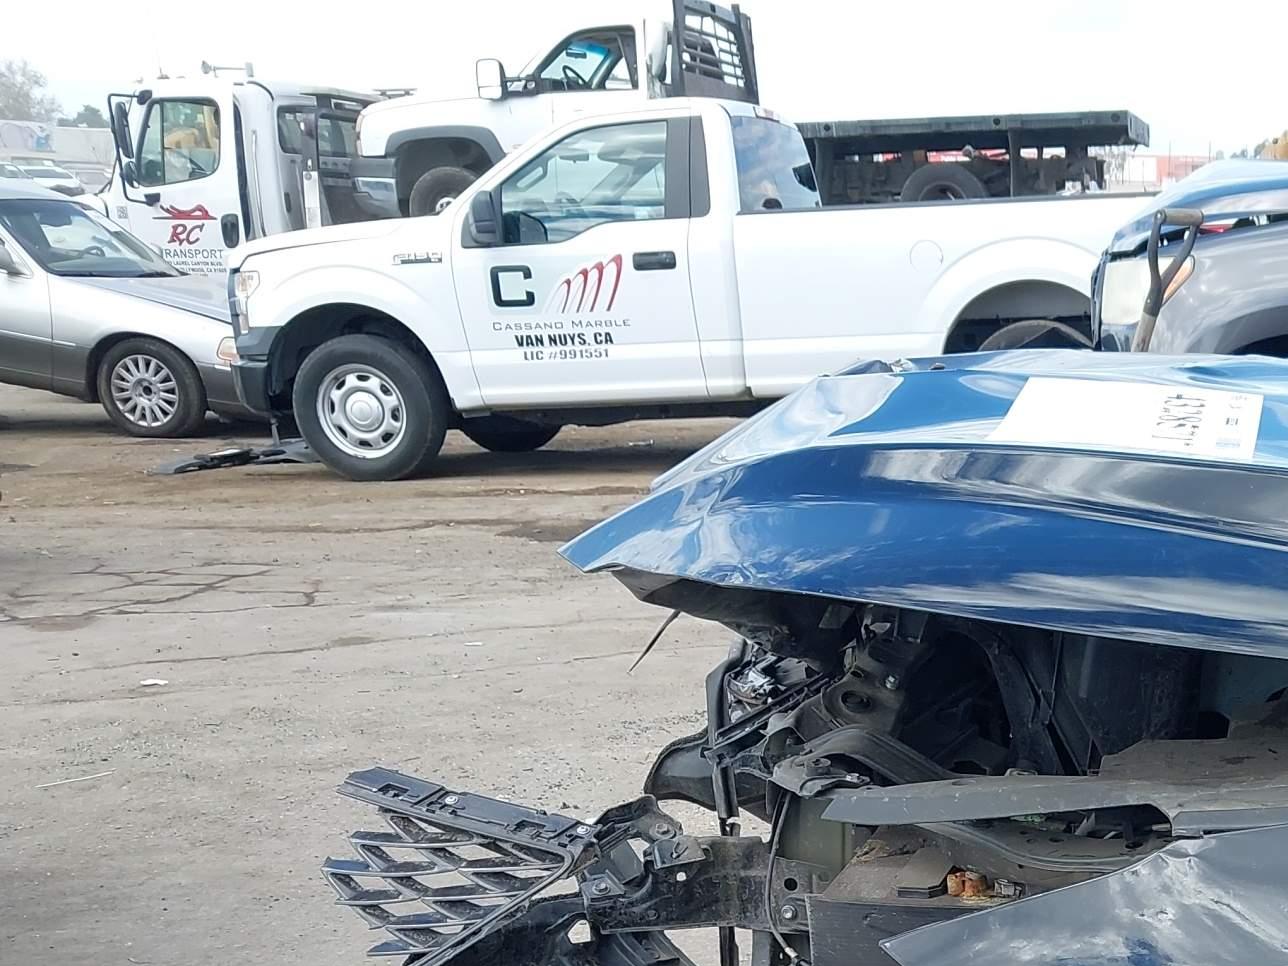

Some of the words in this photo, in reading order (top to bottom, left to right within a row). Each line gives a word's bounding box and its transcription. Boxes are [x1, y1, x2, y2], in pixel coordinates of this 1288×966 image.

[167, 223, 205, 246] RC
[162, 248, 224, 259] RANSPORT
[514, 334, 545, 347] VAN
[593, 331, 614, 345] CA
[523, 350, 544, 361] LIC
